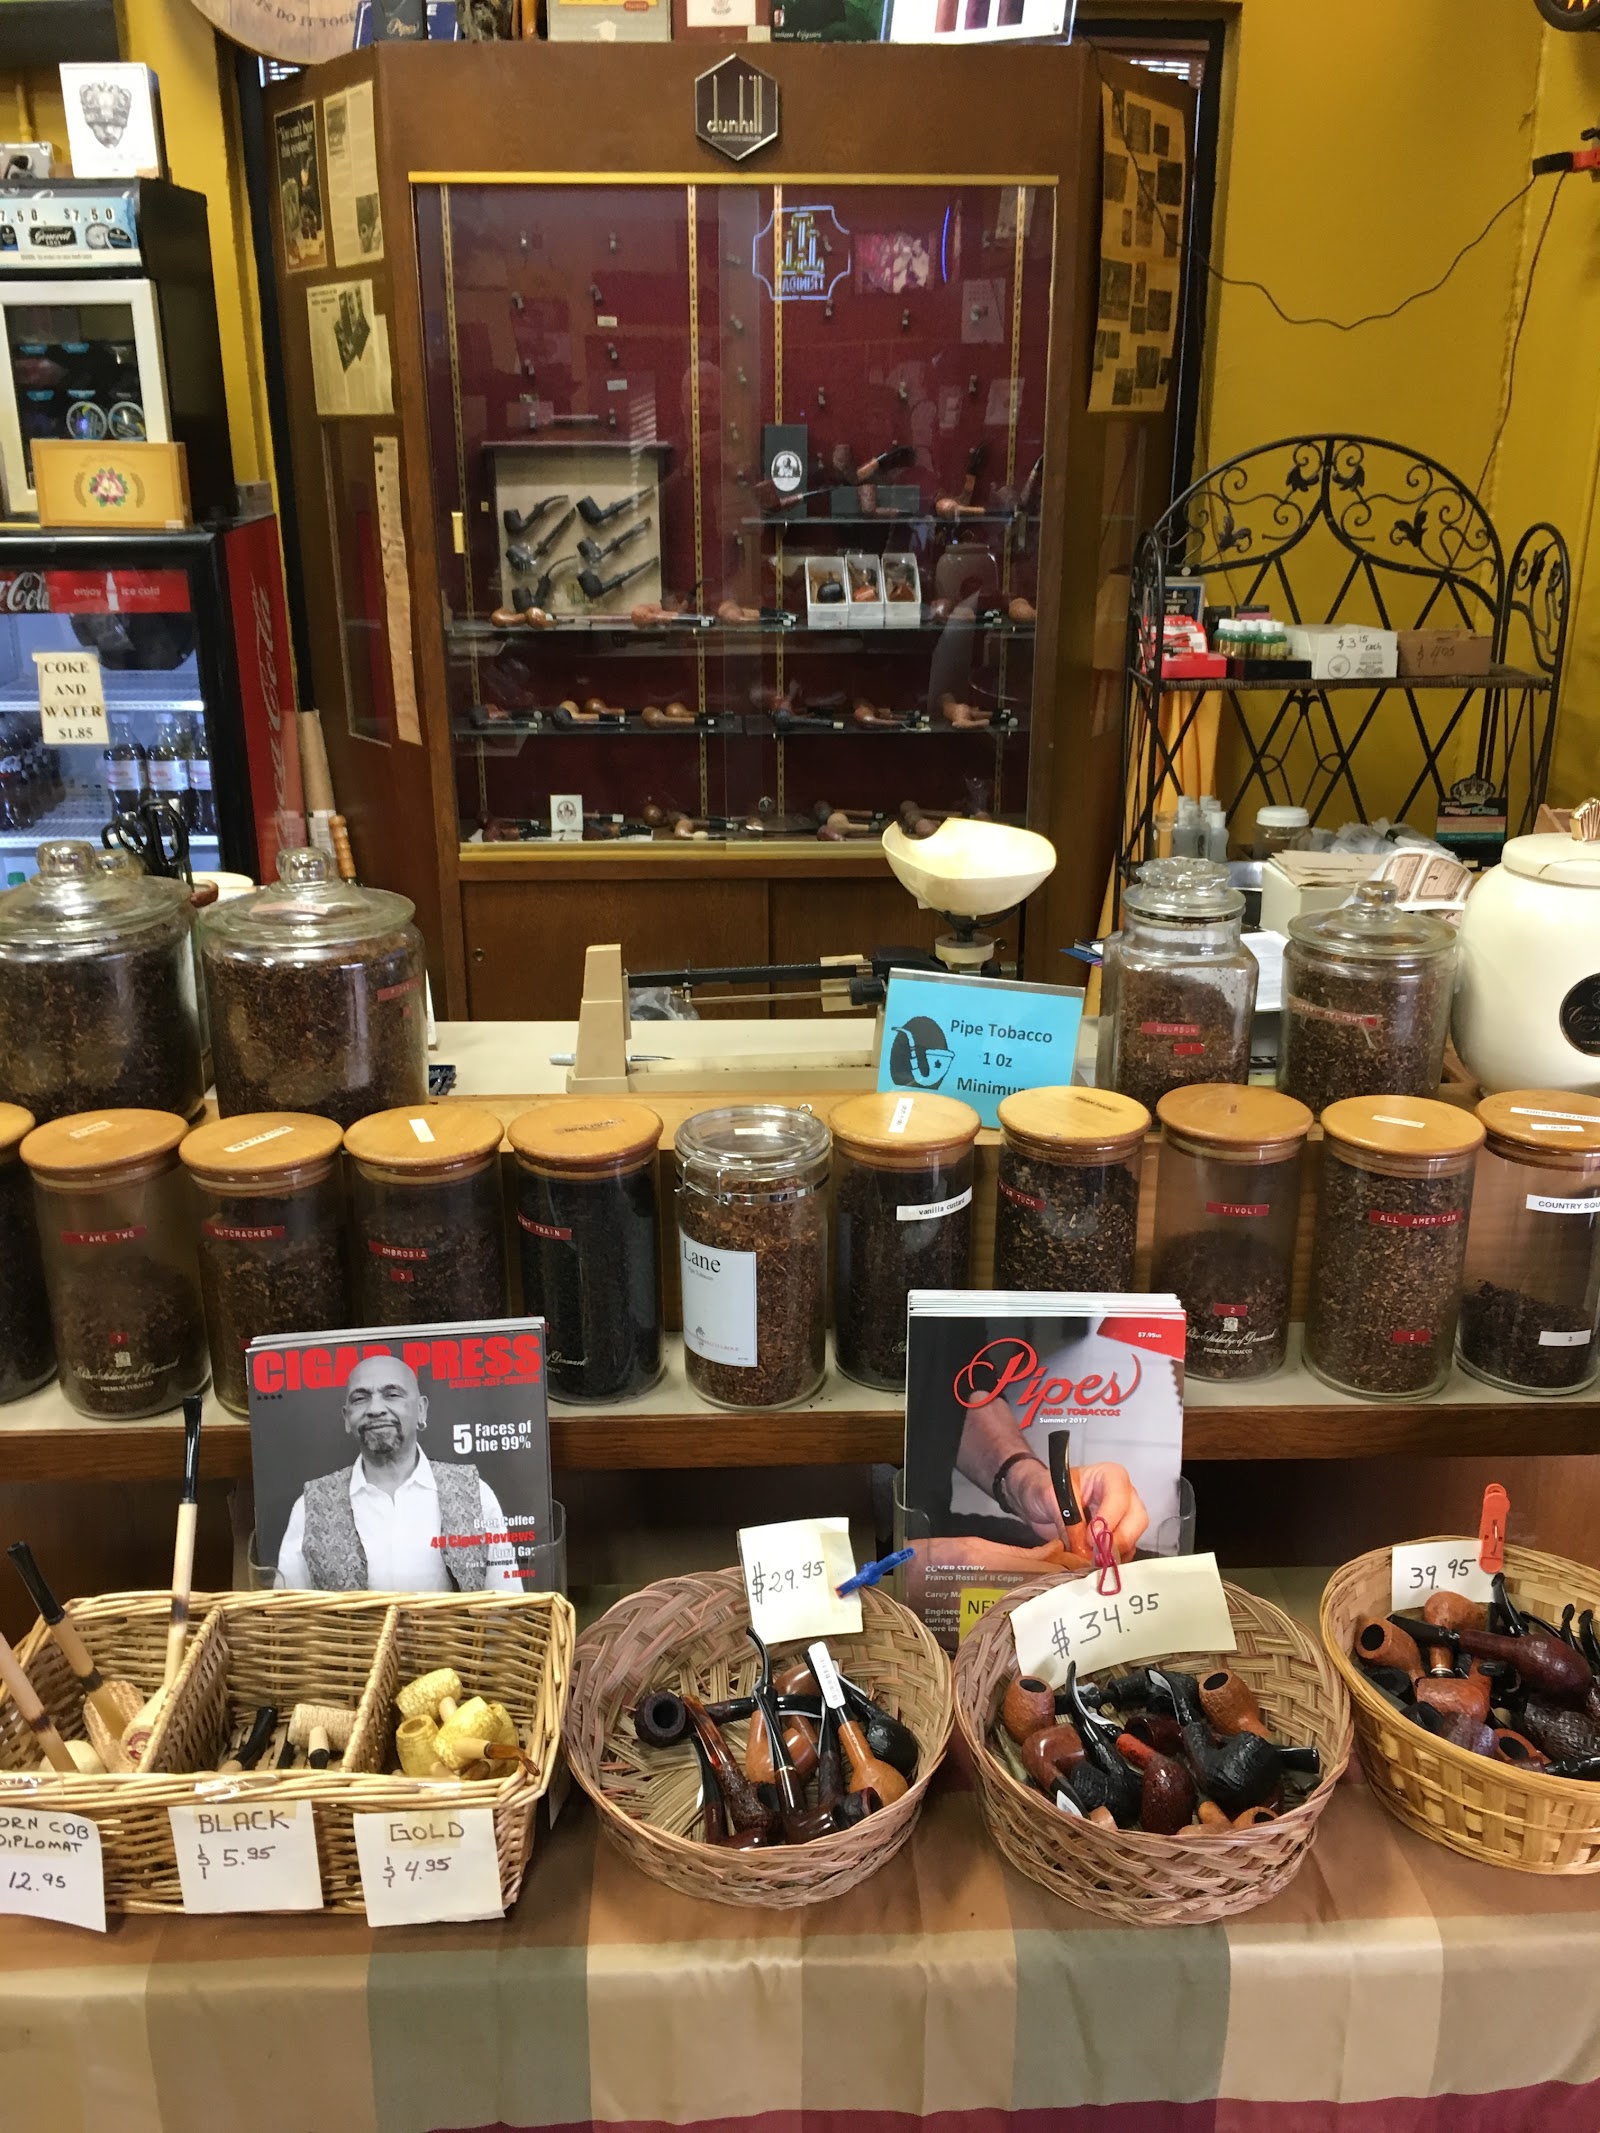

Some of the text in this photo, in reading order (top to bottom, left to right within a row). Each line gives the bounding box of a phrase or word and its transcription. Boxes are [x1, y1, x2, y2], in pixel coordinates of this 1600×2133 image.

[277, 9, 296, 22] DO
[300, 16, 313, 27] IT
[707, 74, 762, 133] dunhill
[73, 586, 160, 600] enjoy ice cold
[44, 661, 90, 674] COKE
[55, 684, 87, 696] AND
[44, 705, 103, 718] WATER
[58, 727, 93, 740] $1.85
[951, 1019, 1053, 1044] Pipe Tobacco
[982, 1052, 991, 1065] 1
[918, 1197, 965, 1216] vanilla custard
[1016, 1194, 1036, 1208] TUCK
[1538, 1199, 1582, 1210] COUNTRY
[1222, 1206, 1258, 1214] TIVOLI
[1380, 1214, 1457, 1225] ALL AMERICAN
[115, 1230, 135, 1240] TWO
[214, 1228, 274, 1239] NUTCRACKER
[535, 1225, 561, 1237] TRAIN
[381, 1247, 427, 1259] AMBROSIA
[683, 1240, 721, 1273] Lane
[402, 1333, 542, 1381] PRESS
[1203, 1346, 1228, 1355] PREMIUM
[953, 1337, 1142, 1429] Pipes
[1040, 1408, 1121, 1417] AND TOBACCOS
[1039, 1417, 1068, 1425] Summer
[475, 1419, 533, 1437] Faces of
[453, 1423, 473, 1455] 5
[475, 1435, 532, 1453] the 99%
[501, 1514, 535, 1527] Coffee
[430, 1530, 536, 1549] 49 Cigar Reviews
[486, 1558, 514, 1567] Revenge
[512, 1569, 537, 1578] more
[955, 1574, 977, 1582] Rossi
[979, 1574, 988, 1582] of
[997, 1574, 1024, 1583] Ceppo
[752, 1560, 825, 1605] $29.95
[925, 1591, 949, 1600] Carey
[925, 1616, 953, 1624] curing:
[199, 1809, 291, 1835] BLACK
[49, 1821, 90, 1840] COB
[389, 1821, 466, 1842] GOLD
[8, 1871, 67, 1892] 12.95
